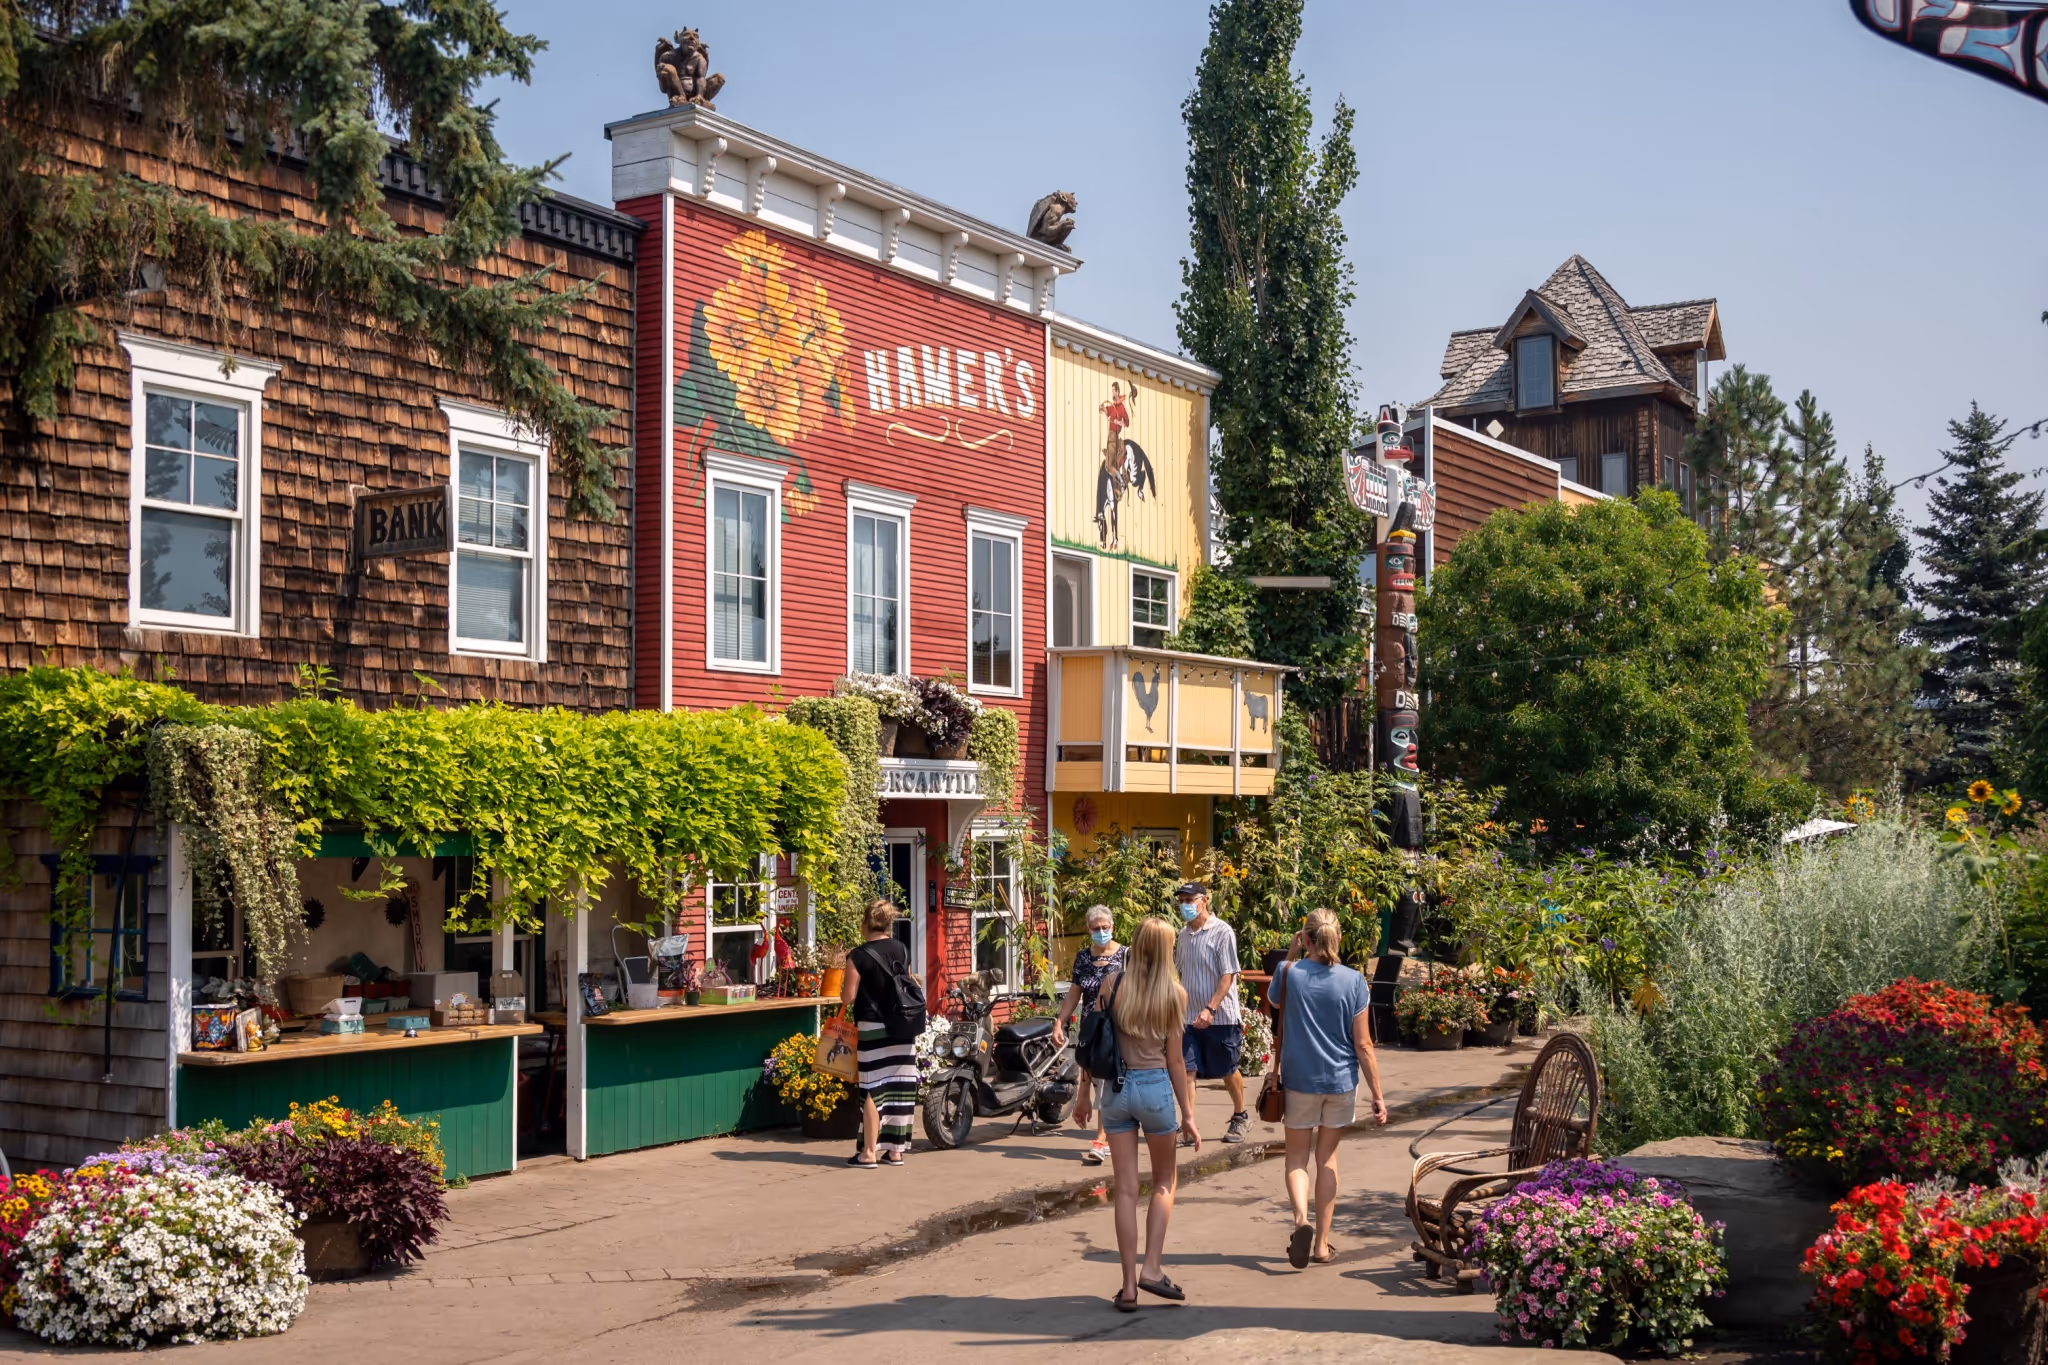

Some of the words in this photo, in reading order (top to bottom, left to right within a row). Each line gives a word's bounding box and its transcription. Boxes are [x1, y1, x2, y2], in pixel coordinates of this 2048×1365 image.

[864, 345, 1037, 421] HAMER'S
[369, 501, 446, 545] BANK
[877, 771, 984, 793] ERCANTIL
[778, 889, 798, 899] CENT
